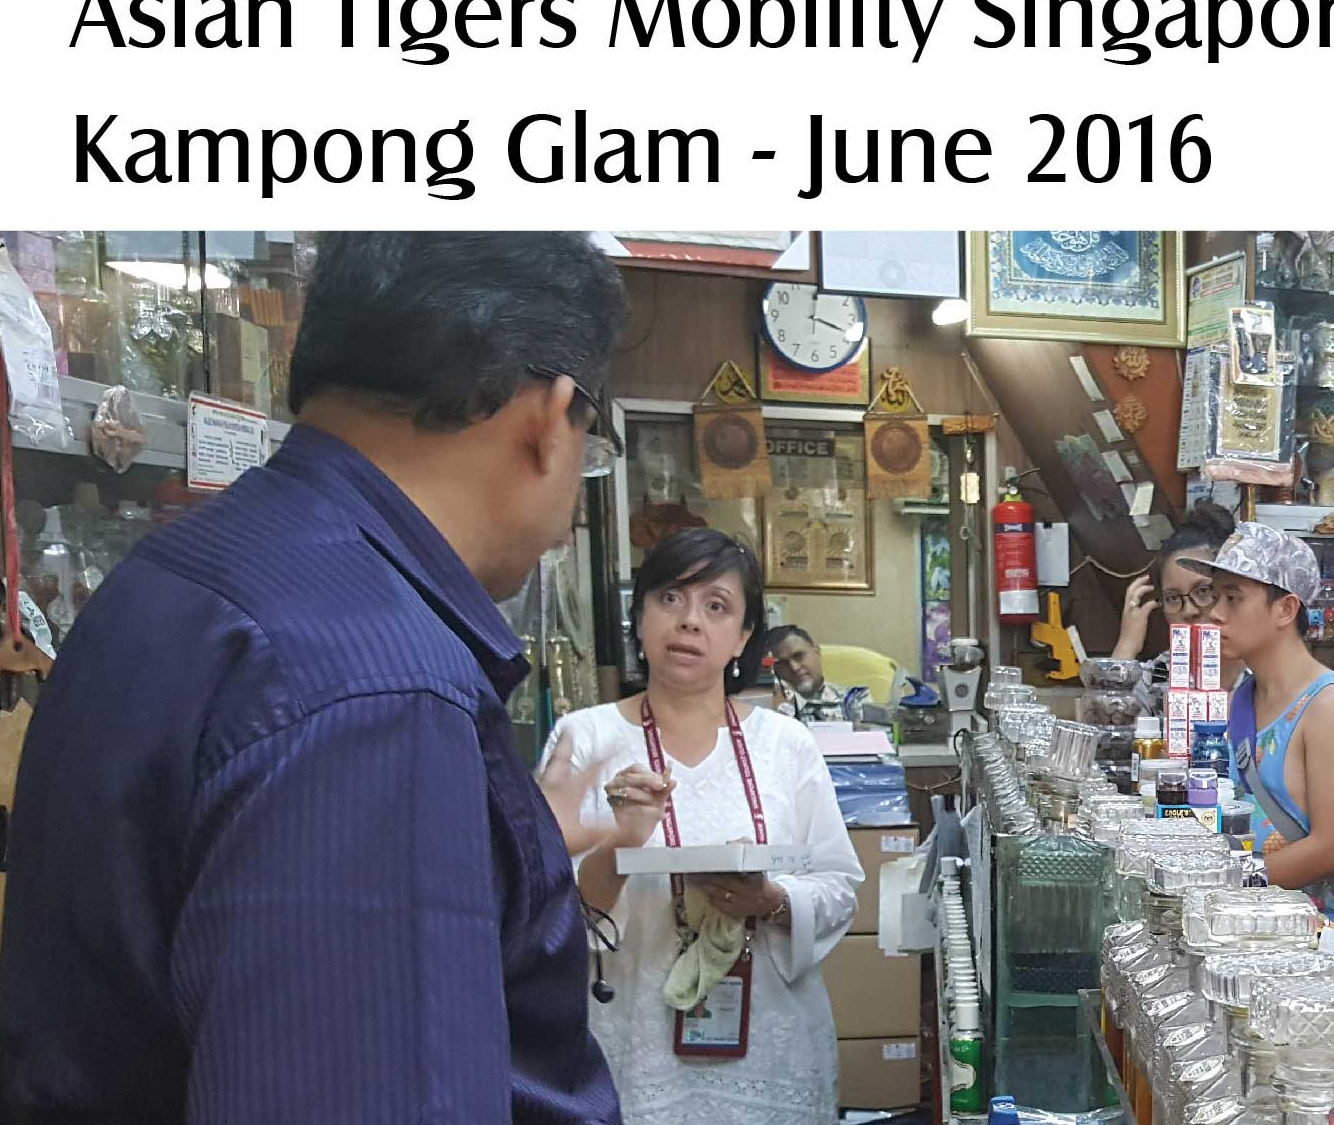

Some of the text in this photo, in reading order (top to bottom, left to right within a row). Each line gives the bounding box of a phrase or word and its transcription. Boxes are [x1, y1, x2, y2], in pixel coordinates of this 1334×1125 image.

[778, 291, 789, 305] 10
[771, 310, 779, 322] 9
[778, 329, 785, 342] 8
[791, 343, 800, 356] 7
[812, 350, 819, 362] 6
[830, 346, 837, 358] 5
[767, 439, 829, 456] OFFICE
